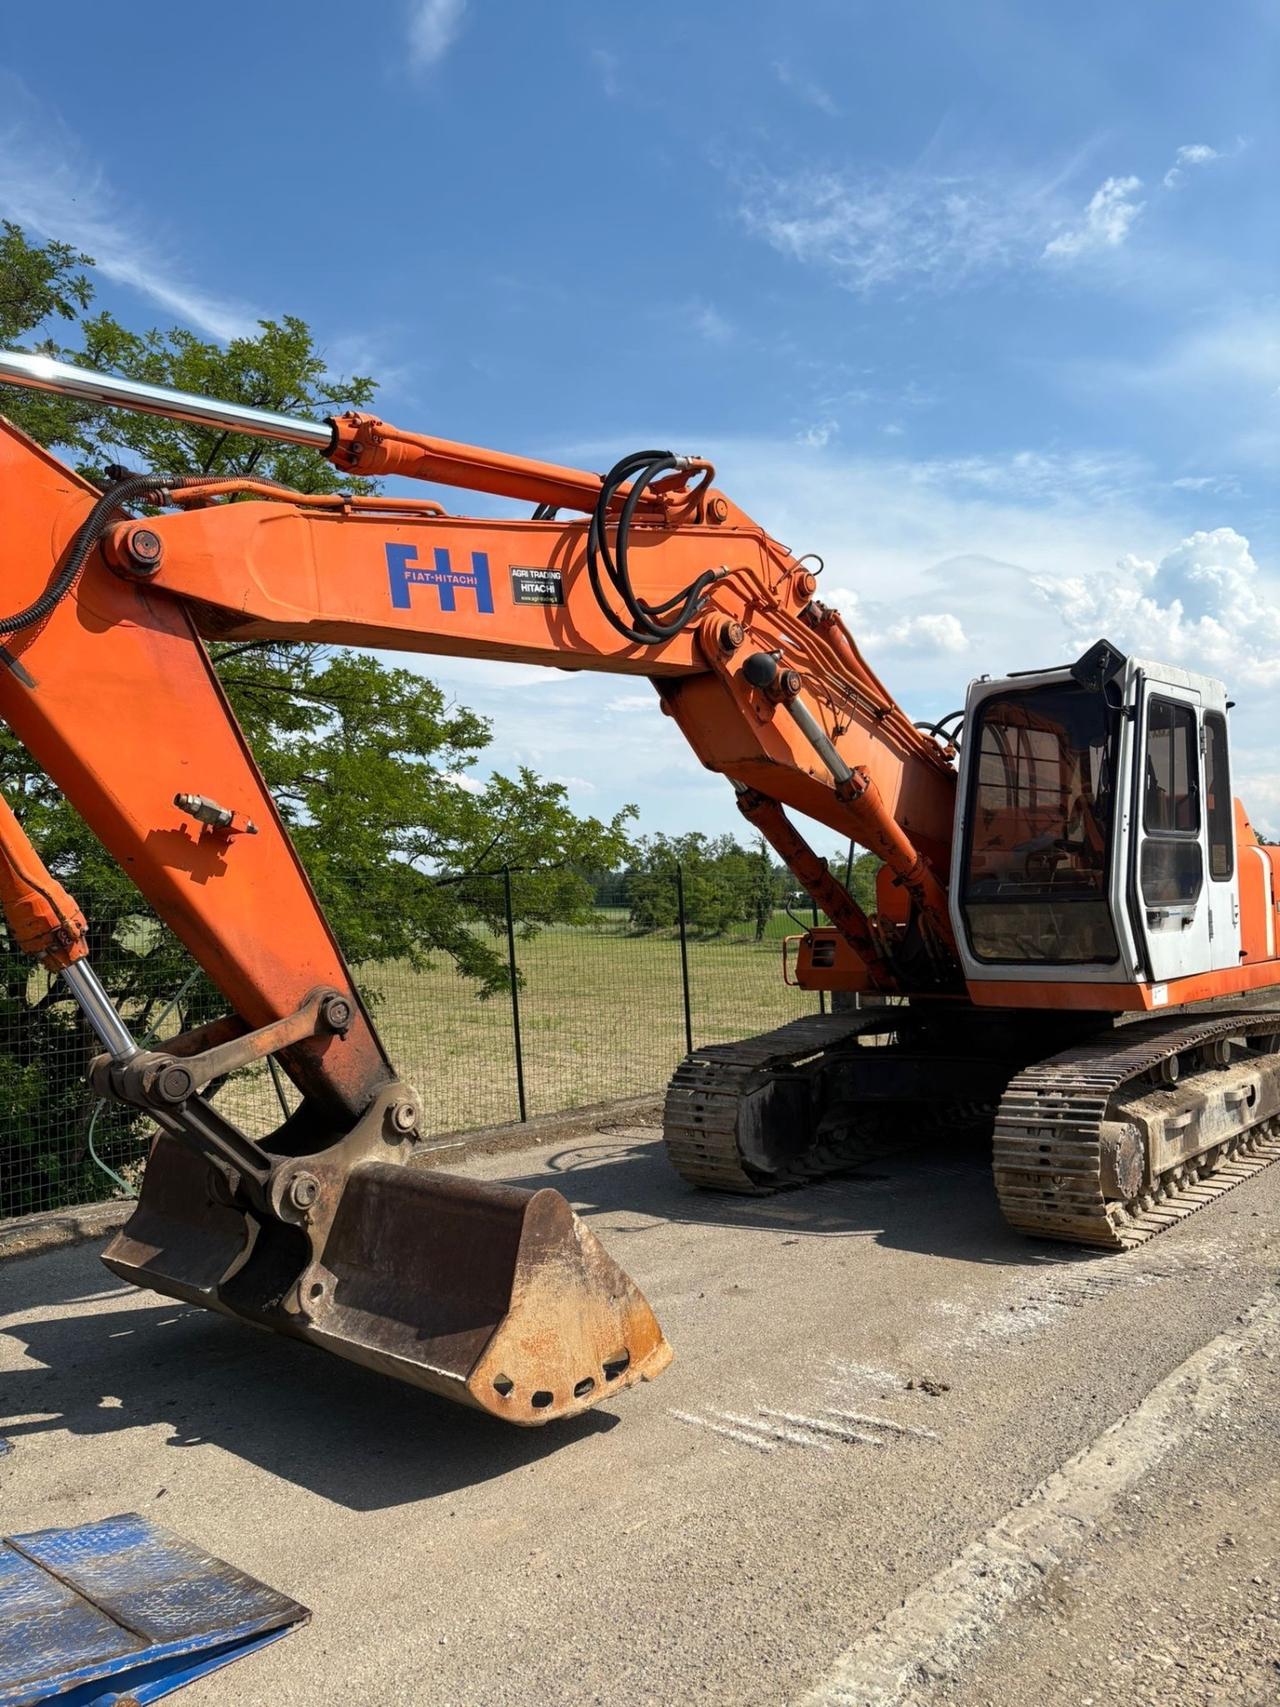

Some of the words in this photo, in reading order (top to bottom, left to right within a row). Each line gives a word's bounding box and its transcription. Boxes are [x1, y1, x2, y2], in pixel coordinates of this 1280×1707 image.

[404, 571, 478, 585] FIAT-HITACHI
[512, 569, 529, 578] AGRI
[530, 570, 561, 580] TRADING
[521, 583, 555, 593] HITACHI
